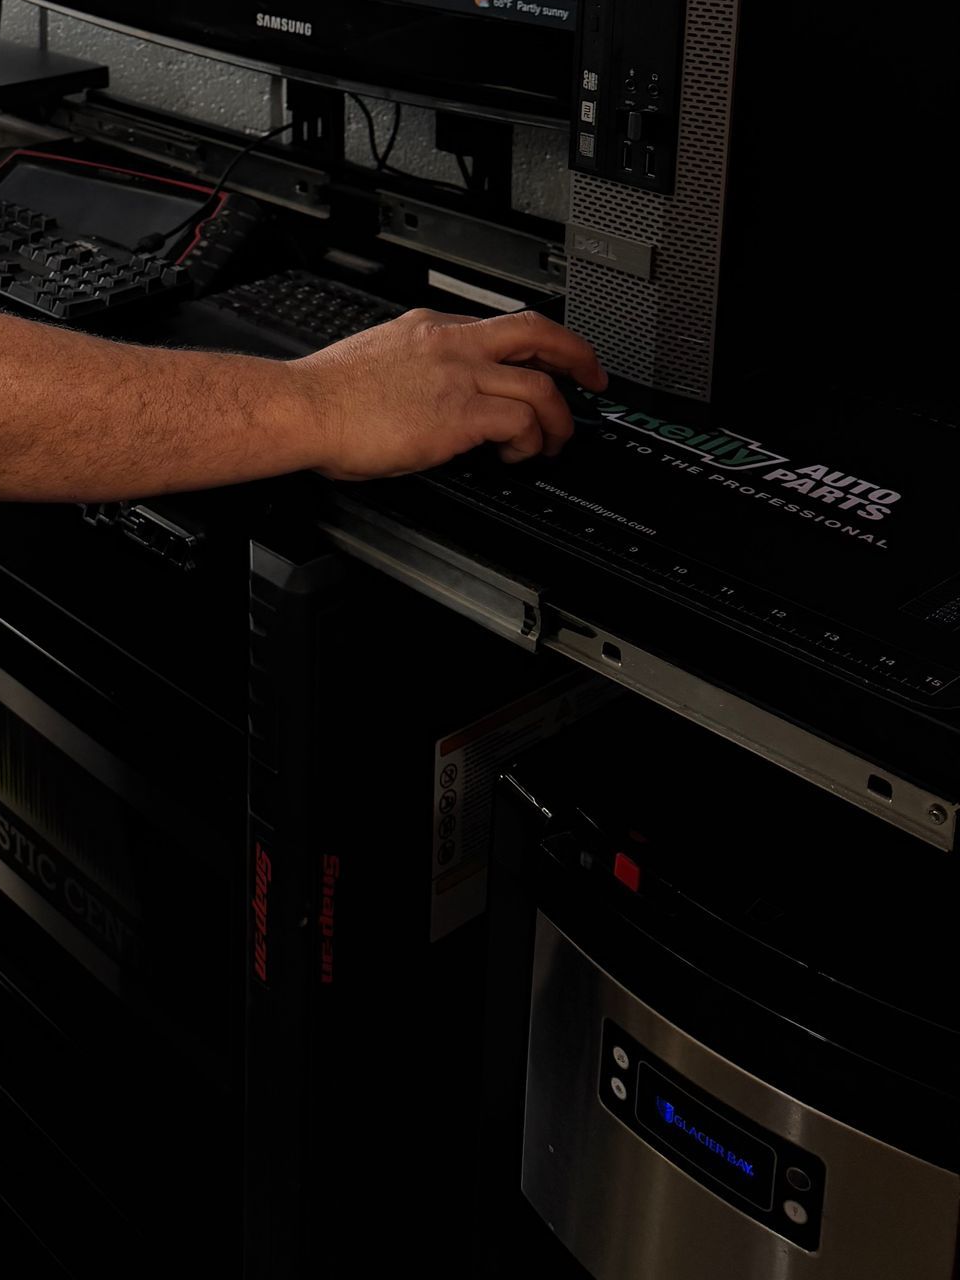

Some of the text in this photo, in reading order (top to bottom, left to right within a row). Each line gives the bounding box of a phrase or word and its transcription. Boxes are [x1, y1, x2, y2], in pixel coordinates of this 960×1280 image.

[516, 0, 541, 16] Partly
[542, 6, 569, 21] sunny
[256, 13, 313, 36] SAMSUNG
[624, 440, 888, 550] TO THE PROFESSIONAL
[762, 468, 892, 521] PARTS
[794, 464, 903, 505] AUTO
[535, 480, 657, 537] www.oreillypro.com
[672, 565, 689, 575] 10
[720, 584, 735, 595] 11
[770, 608, 788, 619] 12
[823, 631, 841, 642] 13
[879, 656, 896, 666] 14
[924, 675, 943, 687] 15
[674, 1114, 726, 1159] GLACIER
